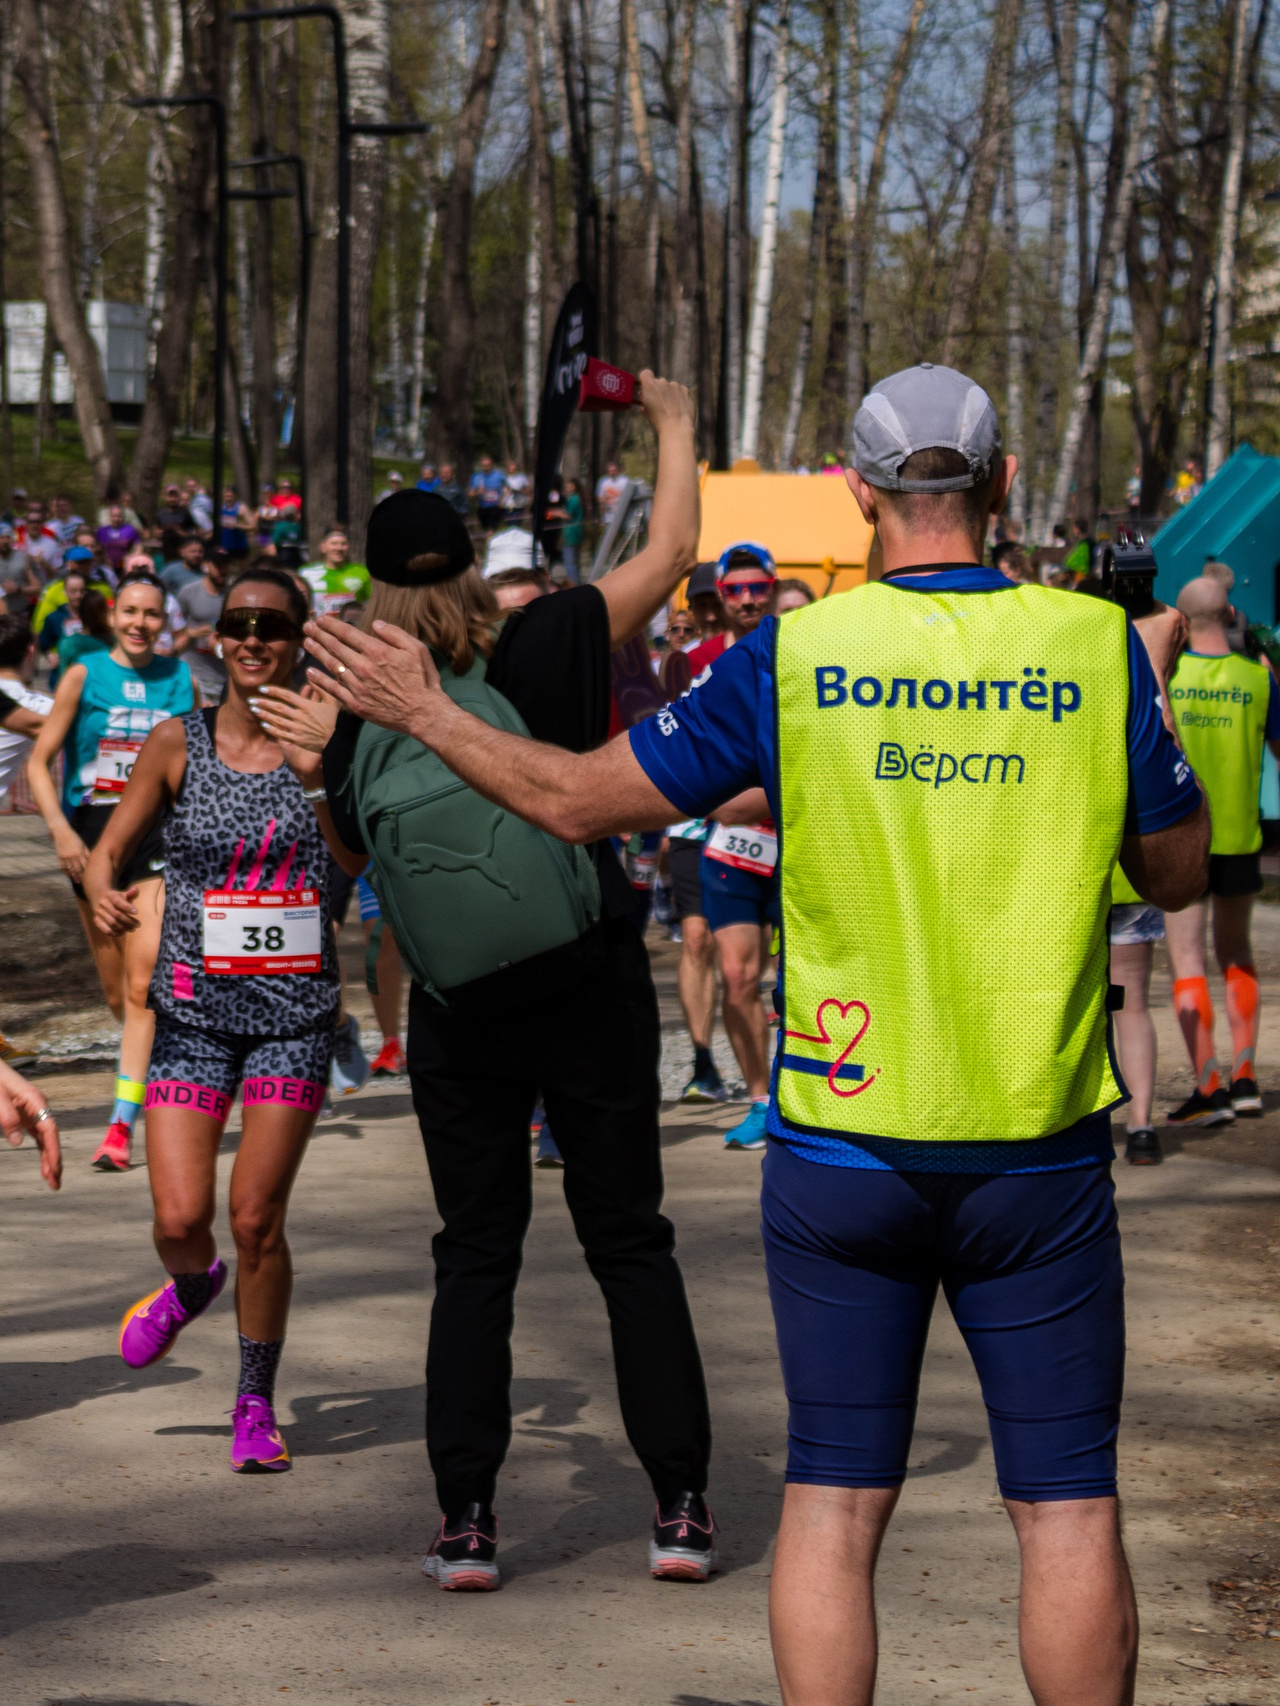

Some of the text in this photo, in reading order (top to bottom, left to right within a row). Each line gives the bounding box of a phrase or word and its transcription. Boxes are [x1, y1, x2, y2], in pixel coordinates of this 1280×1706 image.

[815, 665, 1082, 723] Волонтёр
[1170, 687, 1253, 706] олонтёр
[725, 835, 763, 858] 330
[242, 925, 286, 953] 38
[244, 1081, 317, 1106] NDER
